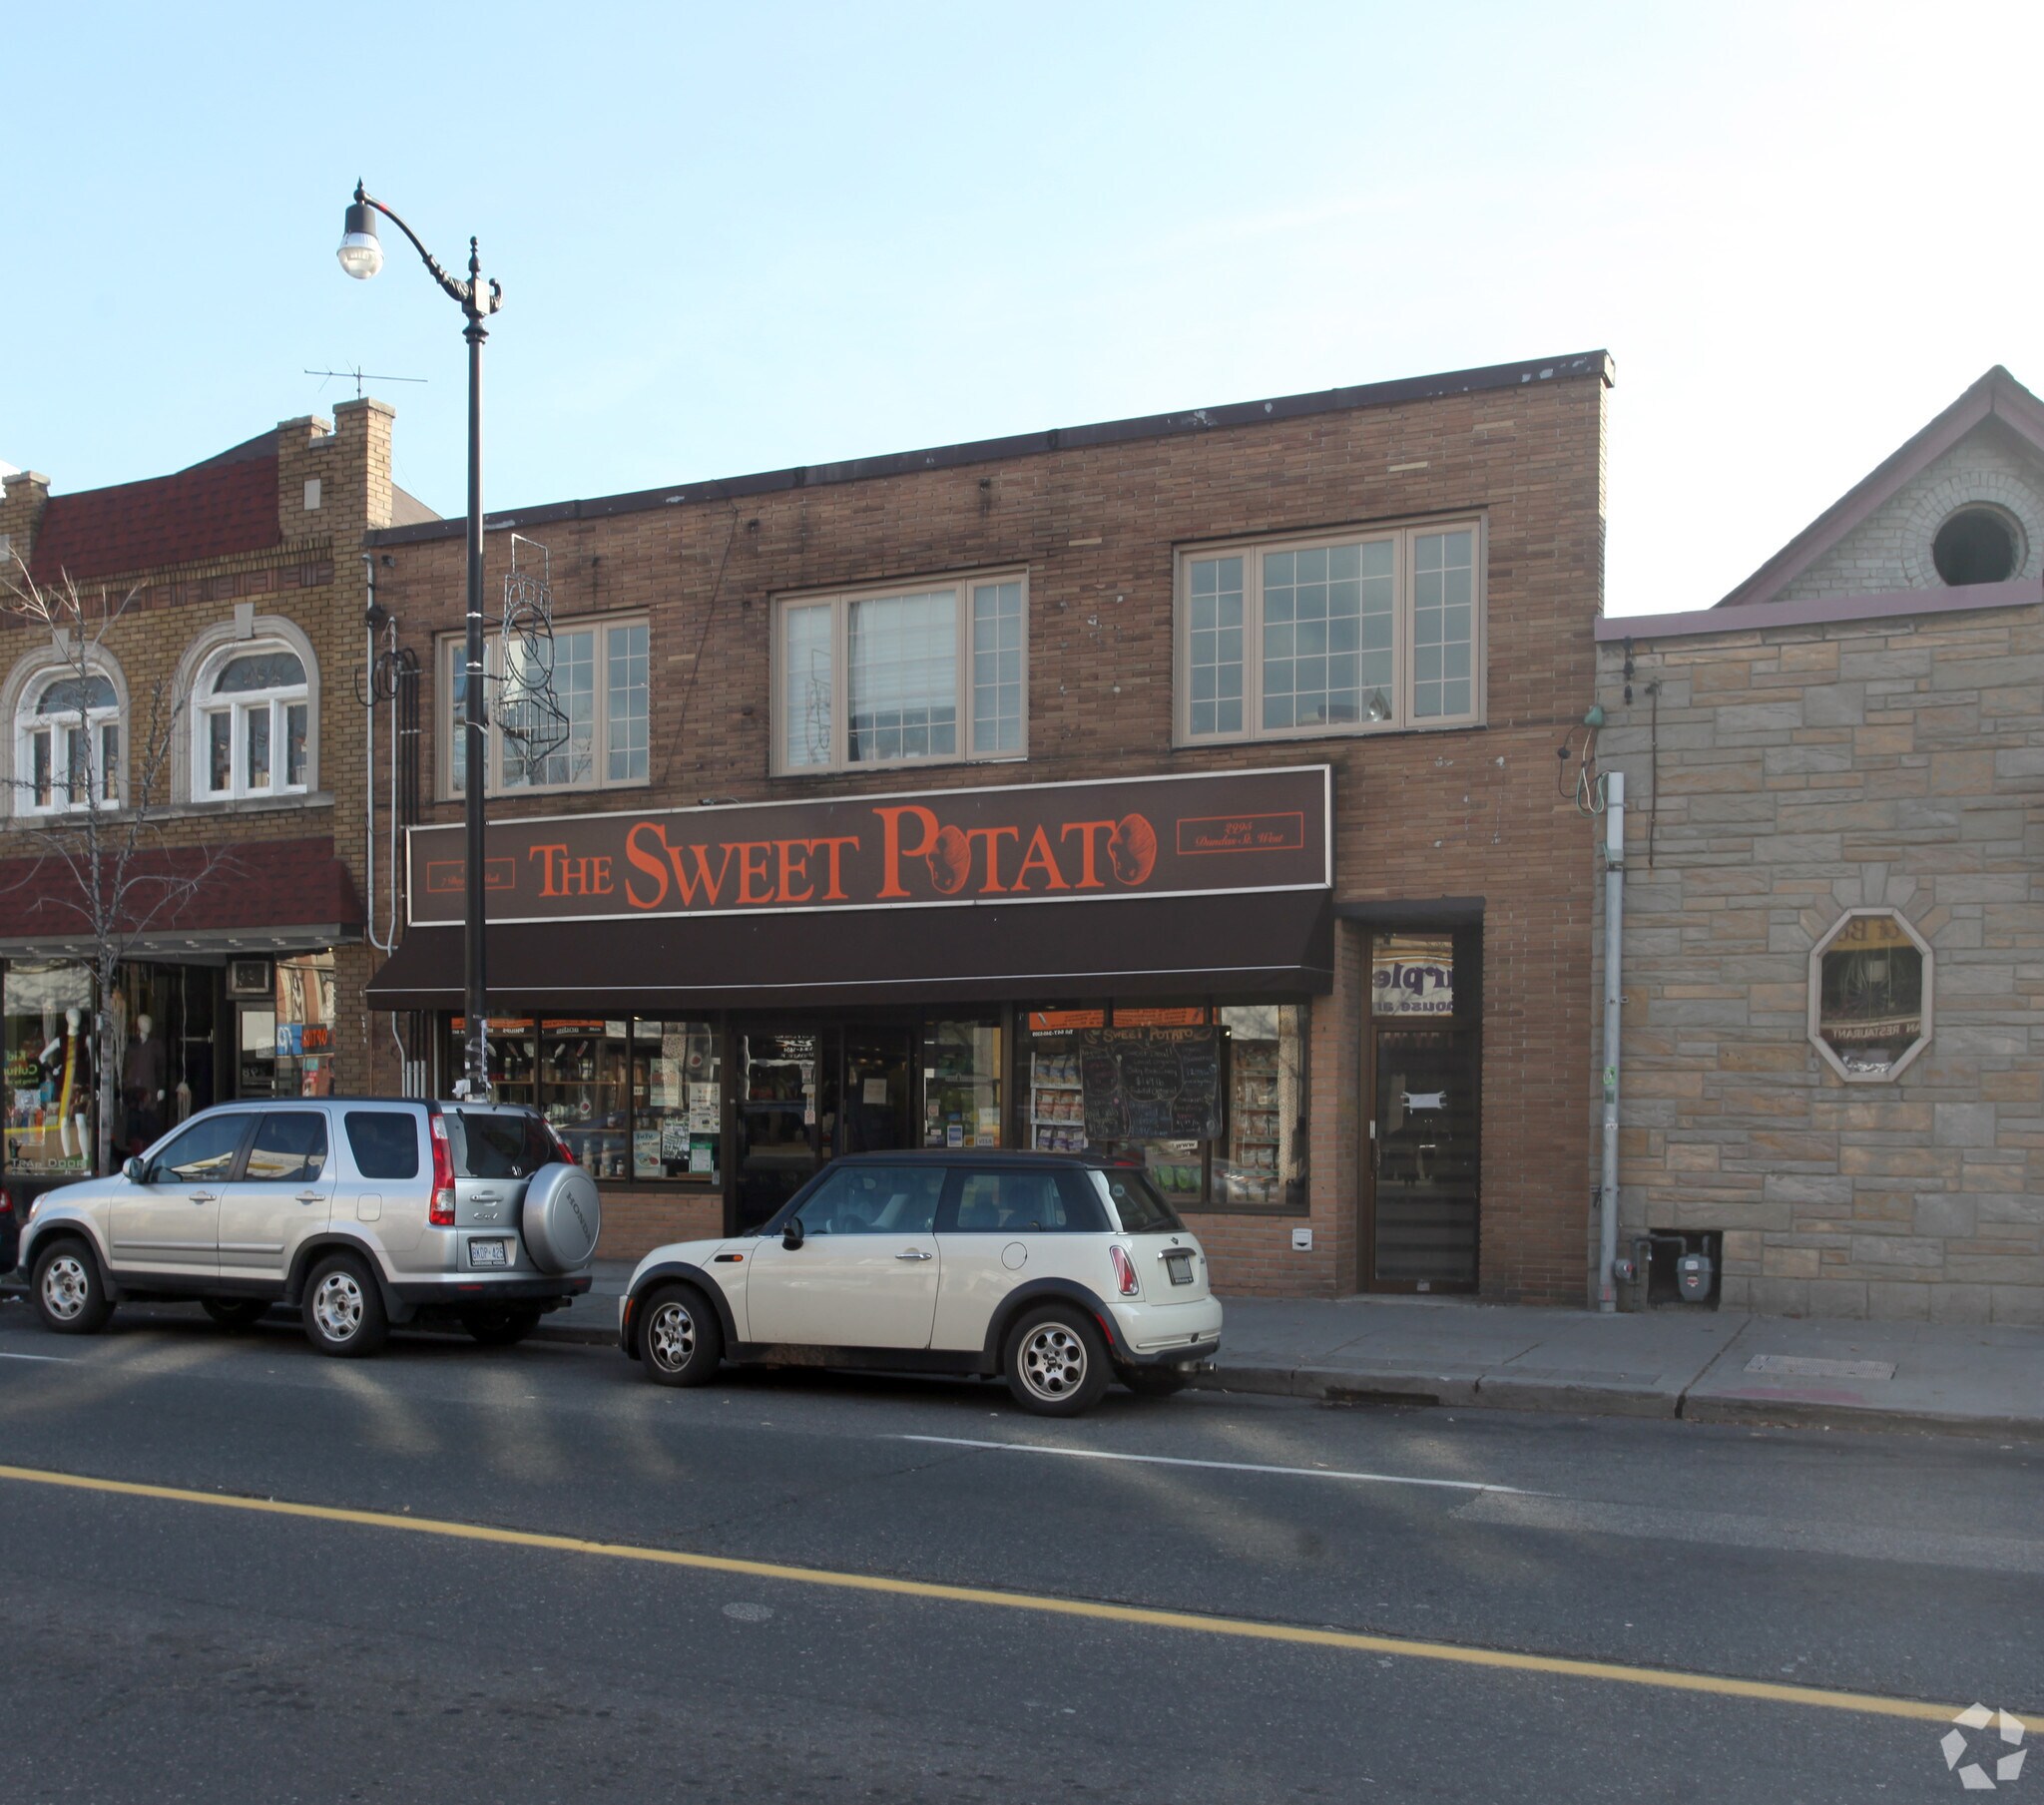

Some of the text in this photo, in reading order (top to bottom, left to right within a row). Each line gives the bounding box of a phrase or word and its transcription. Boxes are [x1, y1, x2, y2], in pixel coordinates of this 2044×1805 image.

[1196, 836, 1238, 846] Dundas
[1258, 832, 1283, 844] West
[625, 821, 860, 910] SWEET
[872, 804, 1158, 899] POTATO
[1150, 1027, 1194, 1042] POTATO
[48, 1157, 88, 1169] DOOR
[566, 1190, 592, 1244] HONDA
